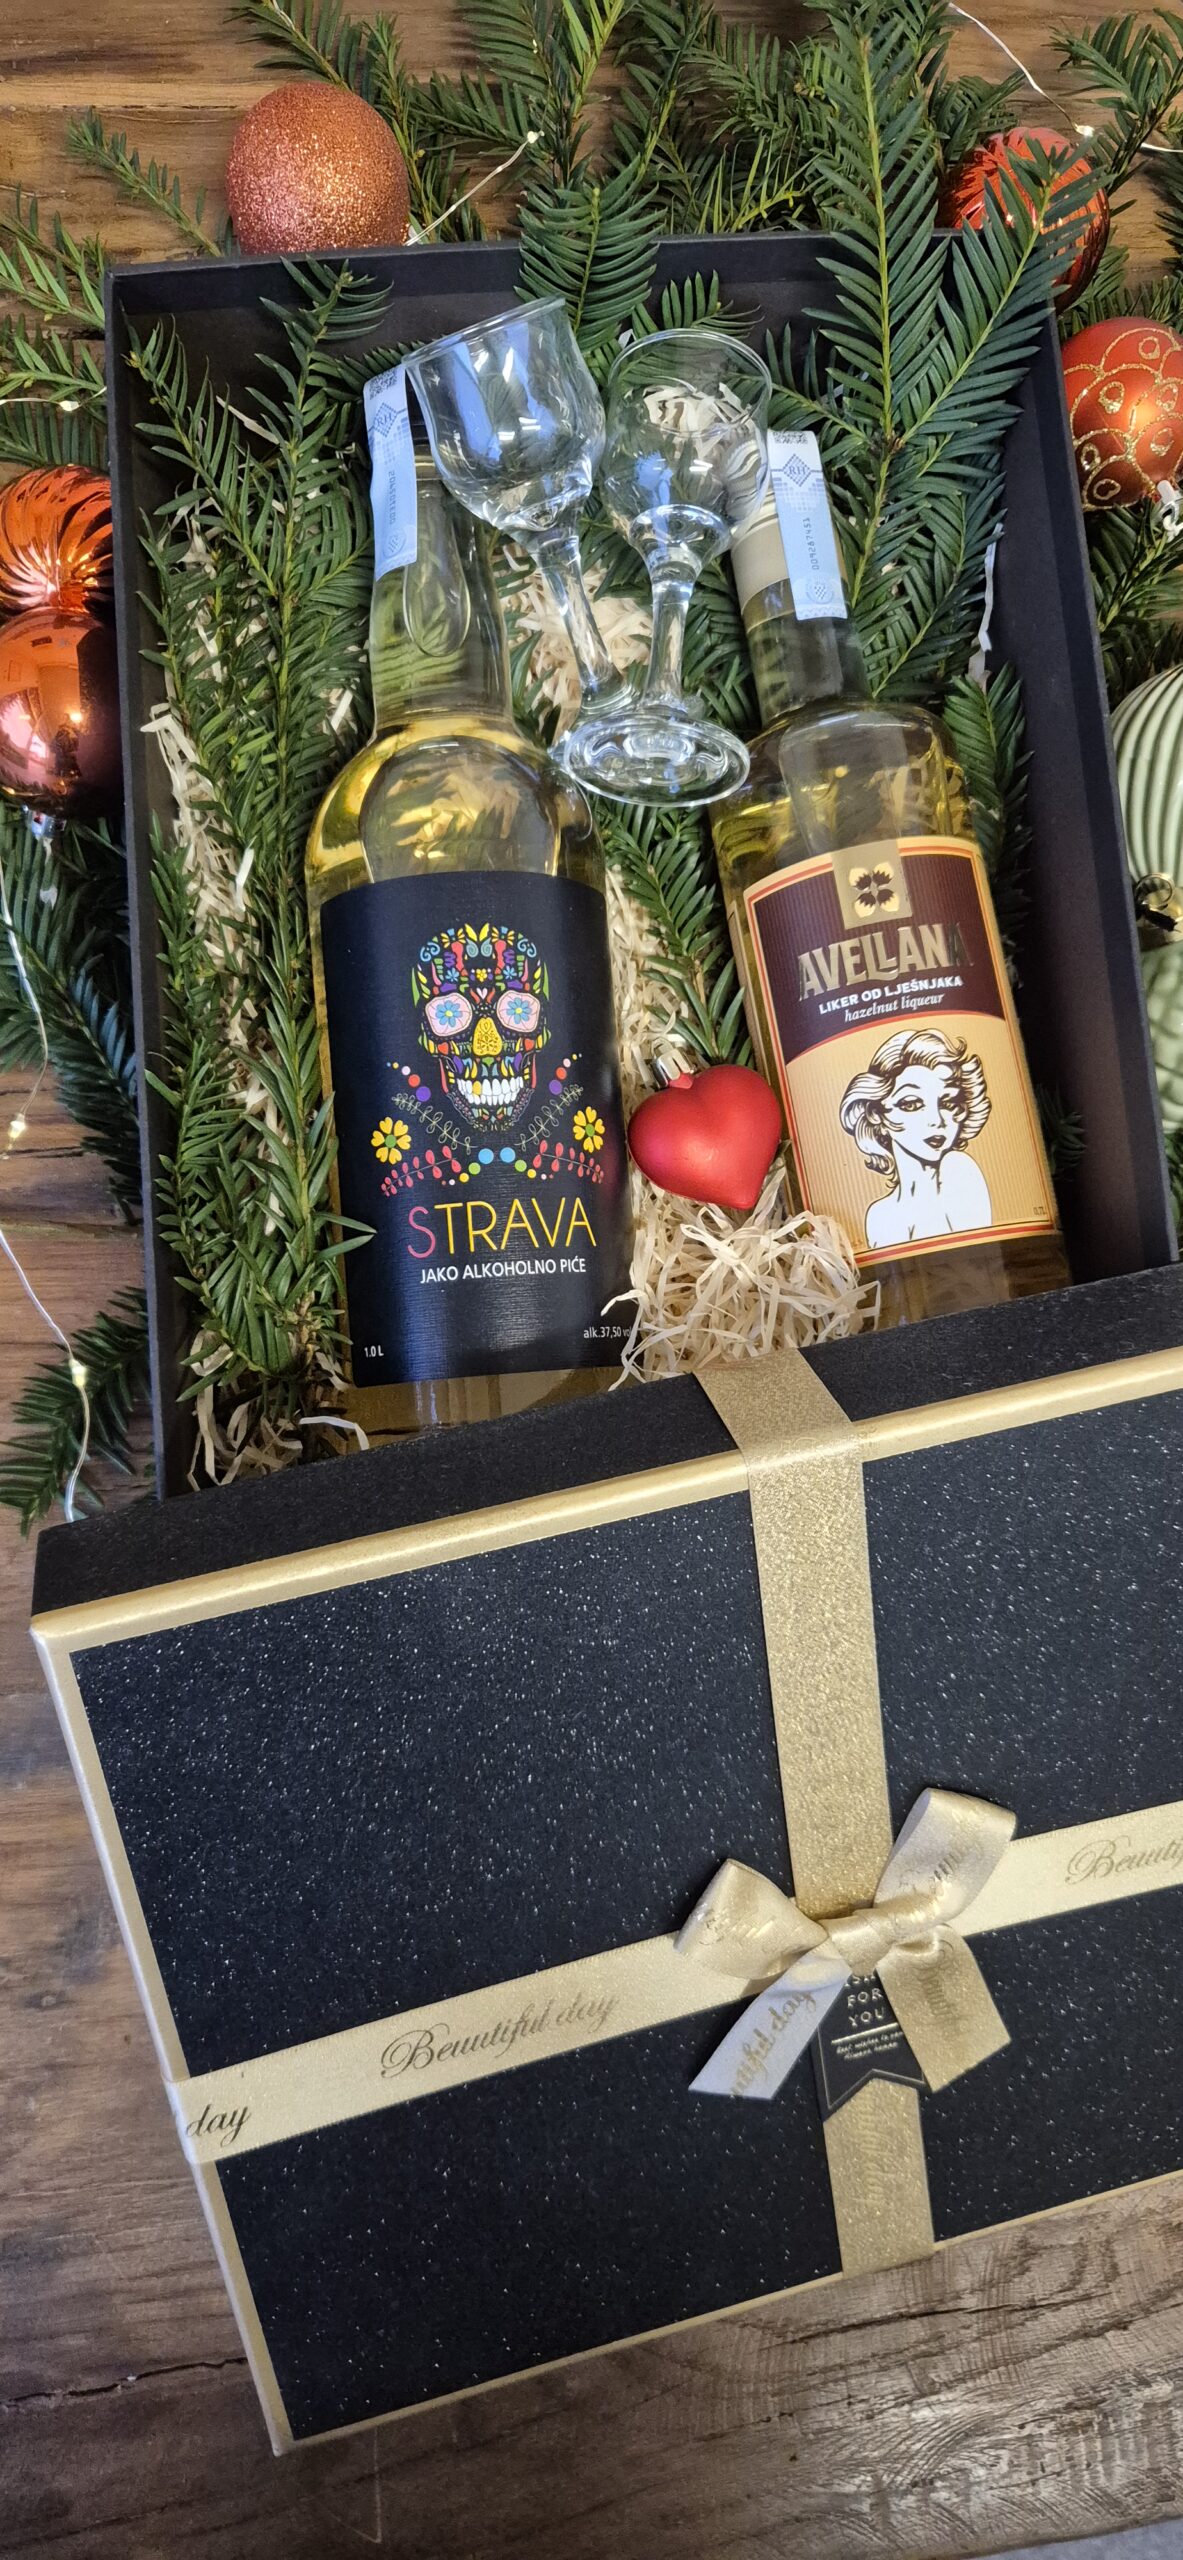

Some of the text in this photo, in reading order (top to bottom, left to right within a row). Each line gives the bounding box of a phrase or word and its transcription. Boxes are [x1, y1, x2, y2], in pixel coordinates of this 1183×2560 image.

[789, 465, 806, 475] RH
[798, 922, 975, 1001] AVELLANA
[818, 975, 963, 1015] LIKER OD LJEŠNJAKA
[844, 993, 946, 1022] hazelnut liqueur
[407, 1197, 598, 1259] STRAVA
[420, 1255, 587, 1284] JAKO ALKOHOLNO PIĆE
[364, 1344, 385, 1358] 1.0 L
[556, 1992, 620, 2033] day
[847, 1988, 884, 2009] FOR
[848, 2007, 885, 2027] YOU
[185, 2103, 252, 2148] day
